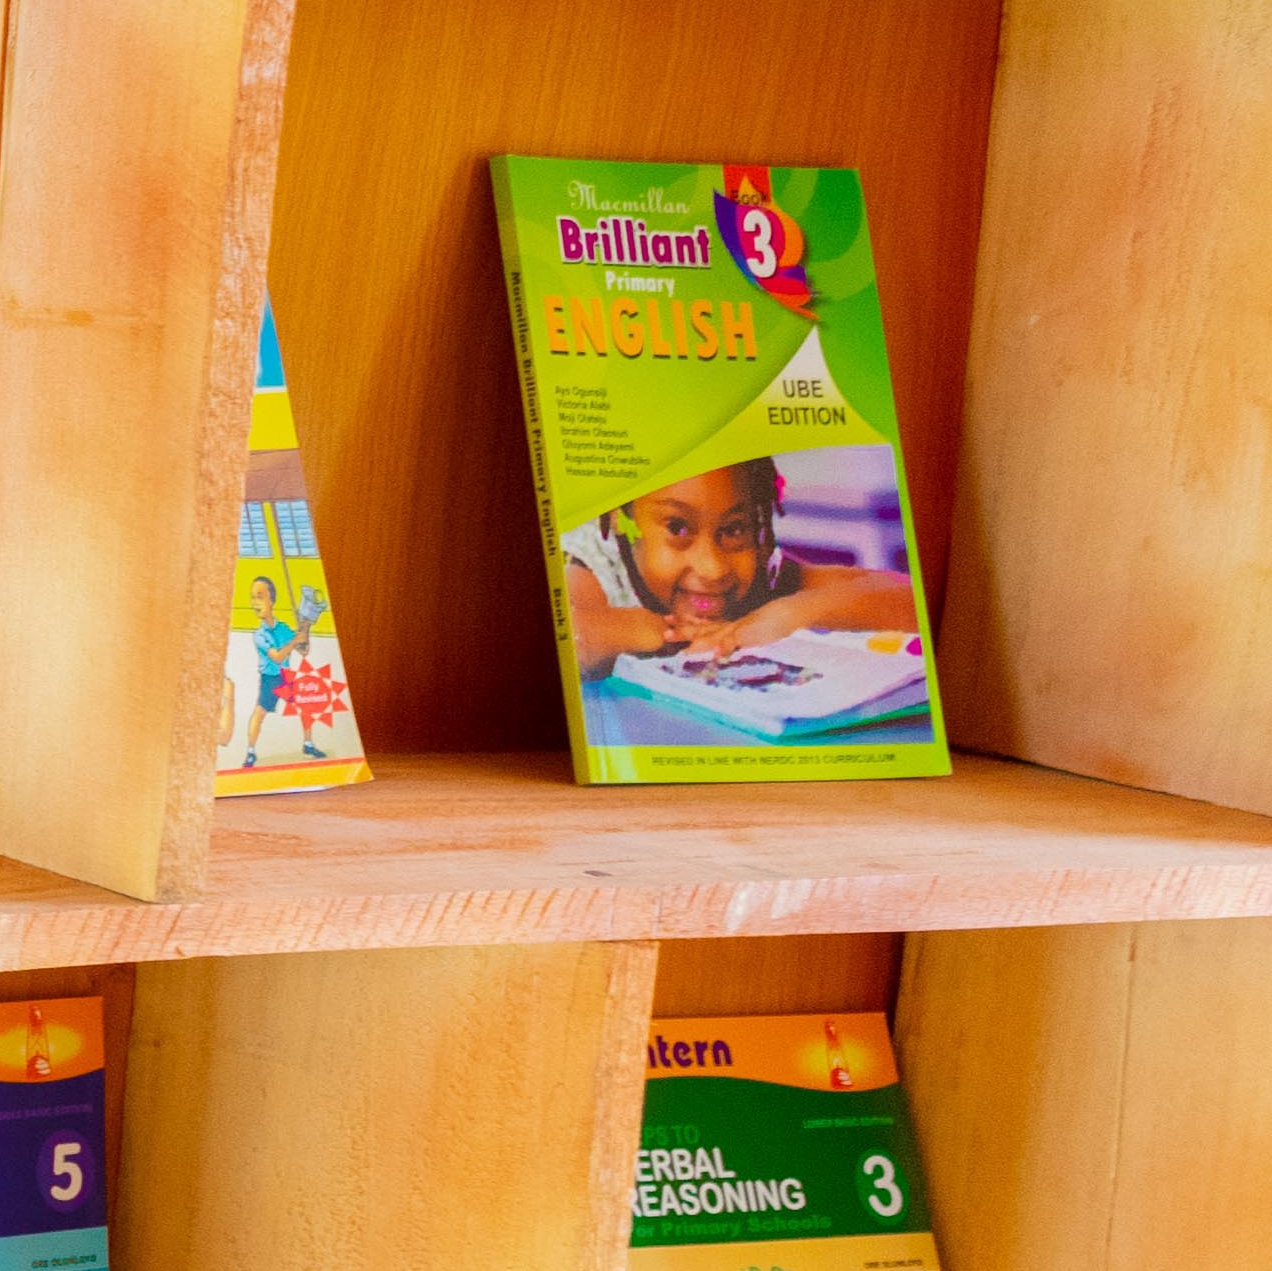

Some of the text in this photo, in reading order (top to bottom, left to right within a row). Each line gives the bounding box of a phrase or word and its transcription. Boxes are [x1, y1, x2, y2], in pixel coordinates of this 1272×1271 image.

[568, 180, 689, 214] Macmillan
[558, 216, 710, 267] Brilliant
[743, 209, 777, 278] 3
[606, 271, 675, 296] Primary
[544, 295, 756, 361] ENGLISH
[782, 381, 823, 399] UBE
[768, 407, 846, 425] EDITION
[50, 1142, 83, 1201] 5
[637, 1148, 736, 1182] ERBAL
[863, 1155, 903, 1217] 3
